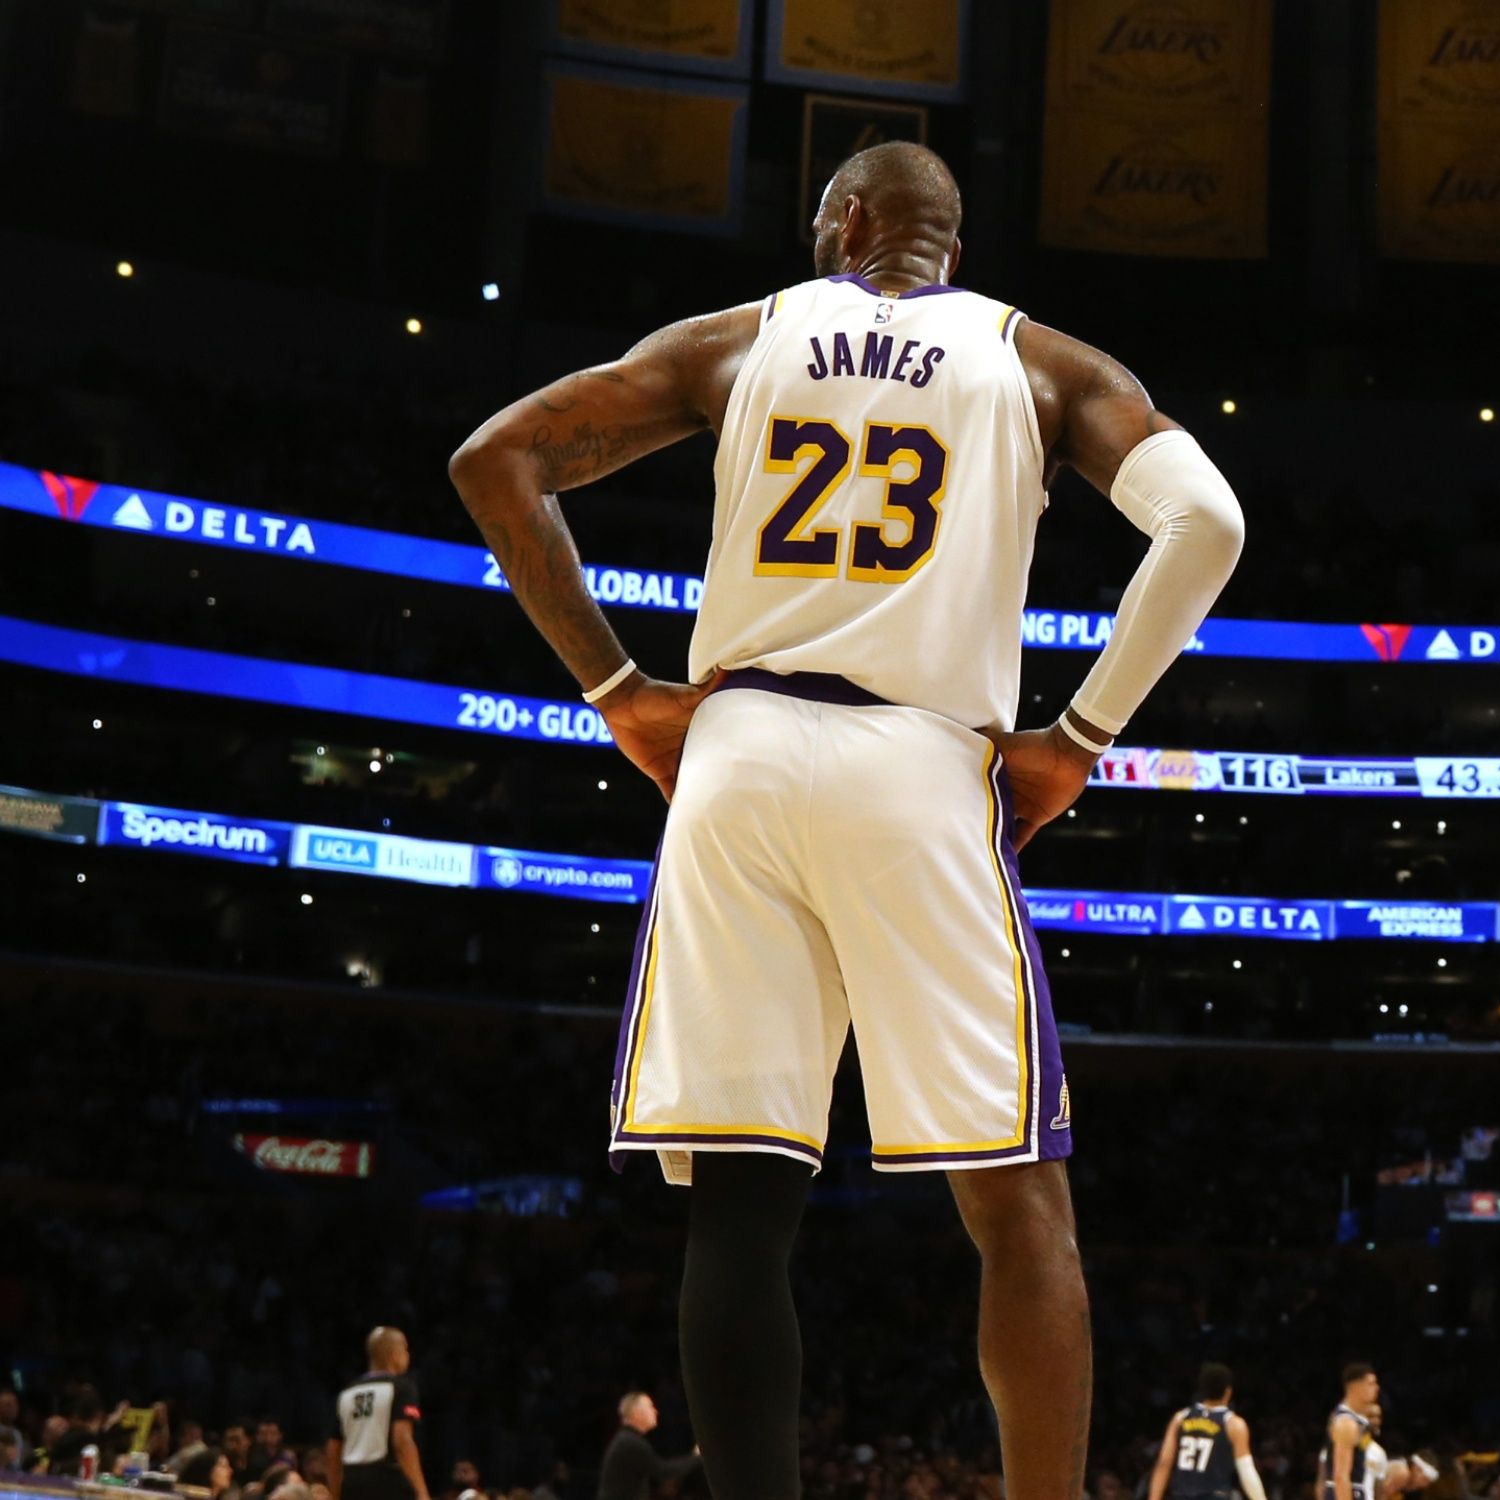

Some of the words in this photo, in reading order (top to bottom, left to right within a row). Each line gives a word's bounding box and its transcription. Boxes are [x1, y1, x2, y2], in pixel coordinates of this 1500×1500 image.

[807, 331, 946, 388] JAMES
[753, 416, 951, 584] 23
[164, 501, 316, 554] DELTA
[457, 692, 533, 732] 290+
[1227, 758, 1292, 789] 116
[1324, 766, 1397, 786] Lakers
[122, 808, 267, 853] Spectrum
[313, 836, 372, 864] UCLA
[386, 847, 464, 875] Health
[523, 863, 634, 890] crypto.com
[1087, 903, 1157, 923] ULTRA
[1213, 906, 1321, 931] DELTA
[1367, 907, 1463, 922] AMERICAN
[1379, 922, 1464, 937] EXPRESS
[254, 1136, 344, 1173] Coca-Cola
[1178, 1435, 1215, 1472] 27
